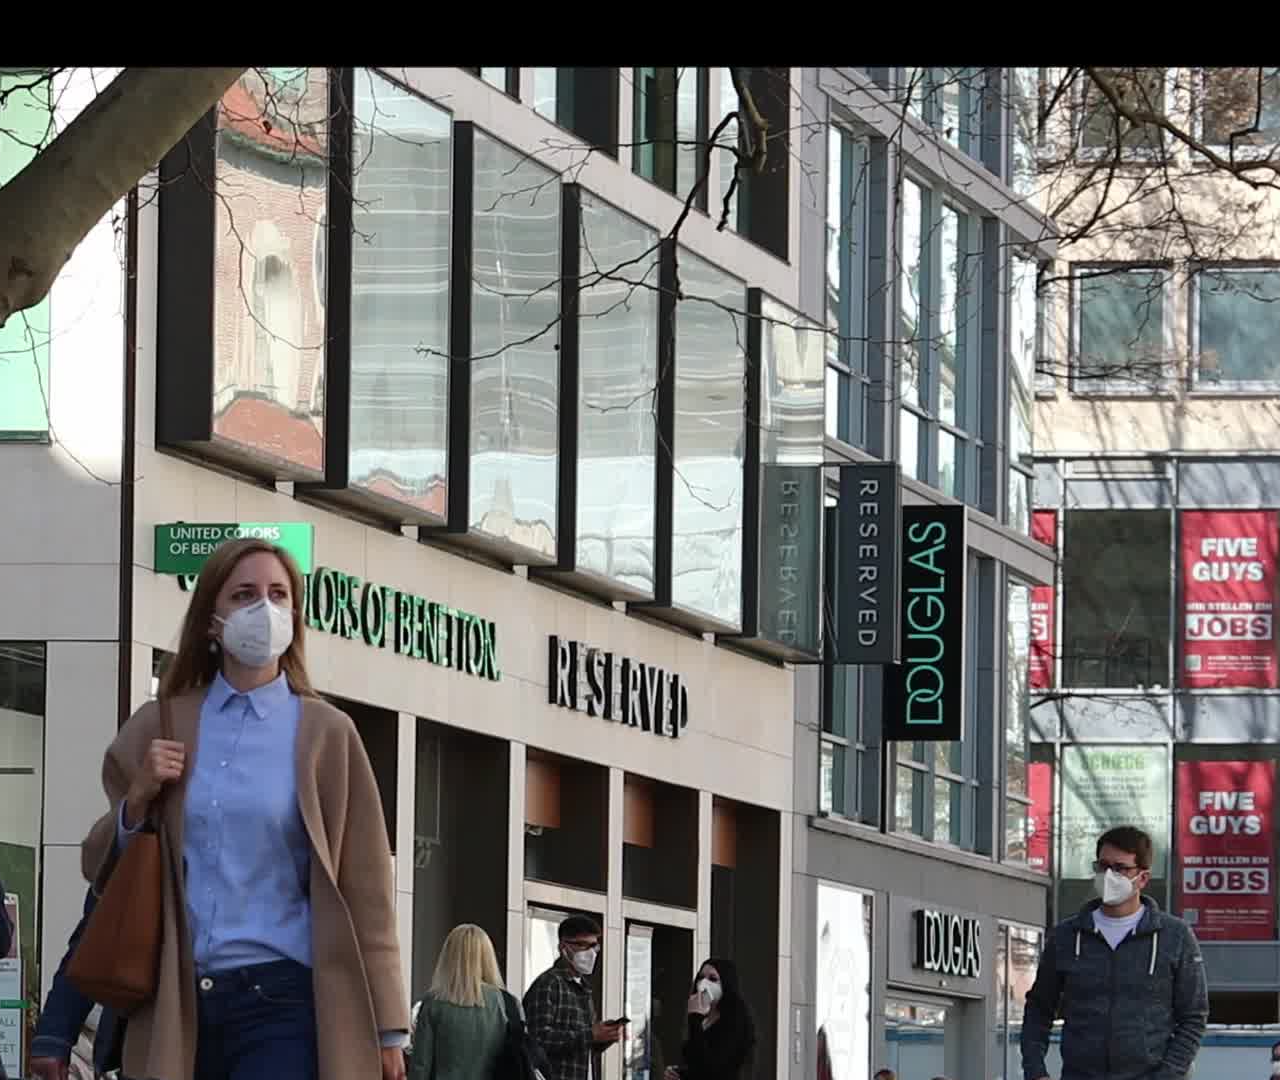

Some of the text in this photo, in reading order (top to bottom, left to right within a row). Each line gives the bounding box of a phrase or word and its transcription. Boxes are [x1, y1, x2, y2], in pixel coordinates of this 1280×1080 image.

[170, 526, 281, 540] UNITED COLORS
[170, 542, 220, 555] OF BEN
[1200, 537, 1258, 558] FIVE
[858, 479, 879, 646] RESERVED
[1192, 561, 1265, 582] GUYS
[304, 567, 362, 640] LORS
[361, 582, 395, 648] OF
[906, 521, 947, 724] DOUGLAS
[1188, 616, 1268, 637] JOBS
[548, 634, 689, 738] RESERVED
[1199, 791, 1255, 811] FIVE
[1189, 815, 1262, 835] GUYS
[1185, 870, 1265, 891] JOBS
[922, 909, 981, 977] DOUGLAS
